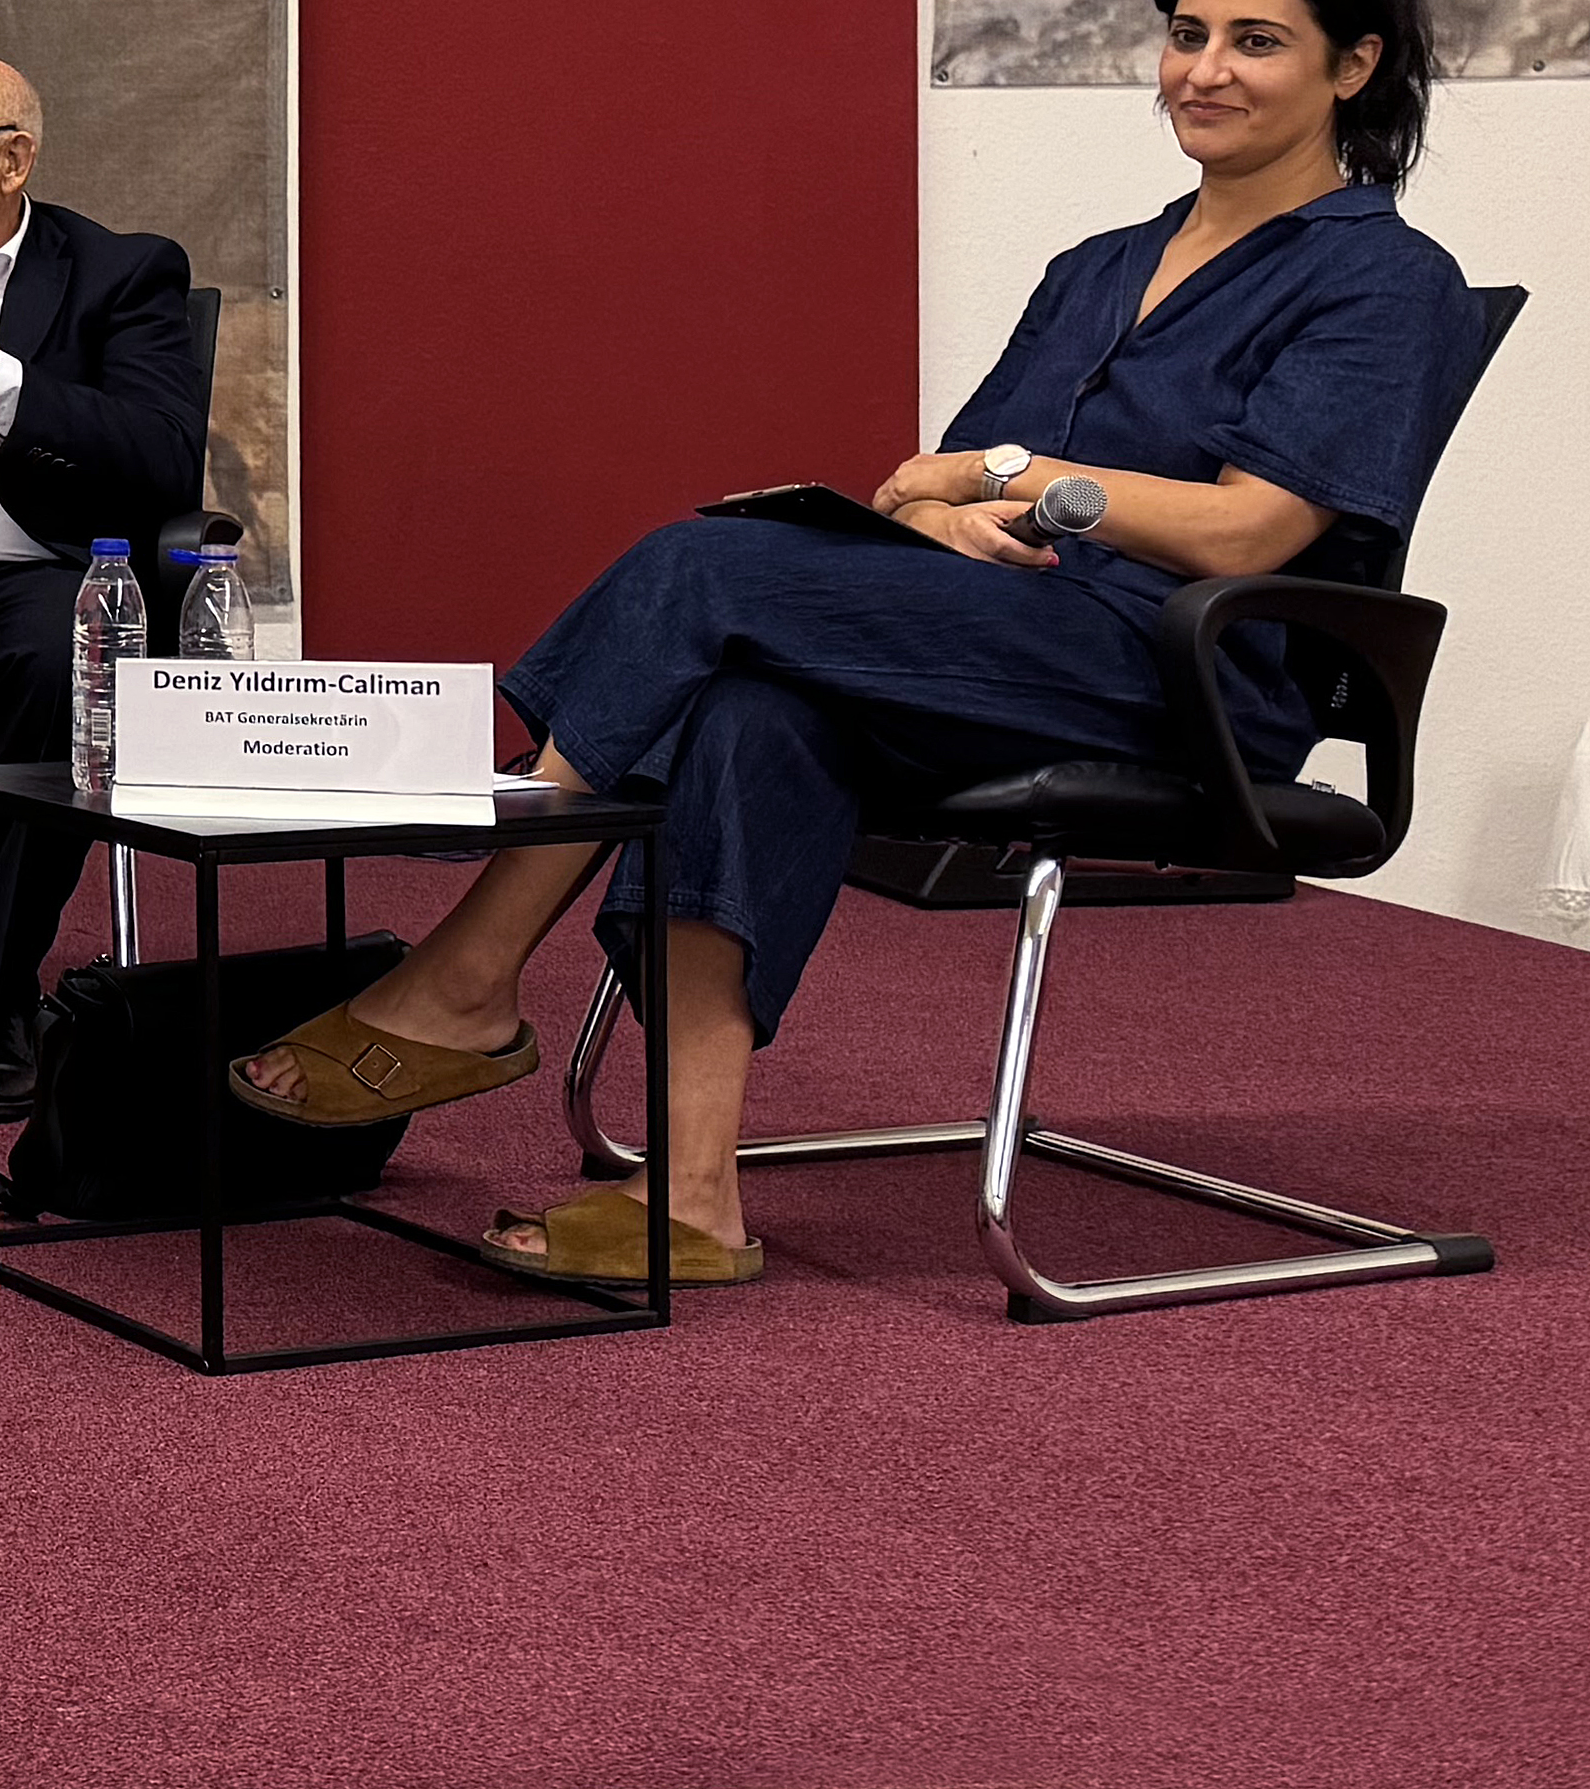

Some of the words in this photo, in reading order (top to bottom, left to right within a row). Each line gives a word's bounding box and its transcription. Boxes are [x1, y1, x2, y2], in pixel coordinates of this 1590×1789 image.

[154, 671, 221, 690] Deniz
[230, 672, 439, 695] Yıldırım-Caliman
[206, 712, 233, 723] BAT
[238, 712, 367, 726] Generalsekretärin
[244, 740, 348, 756] Moderation
